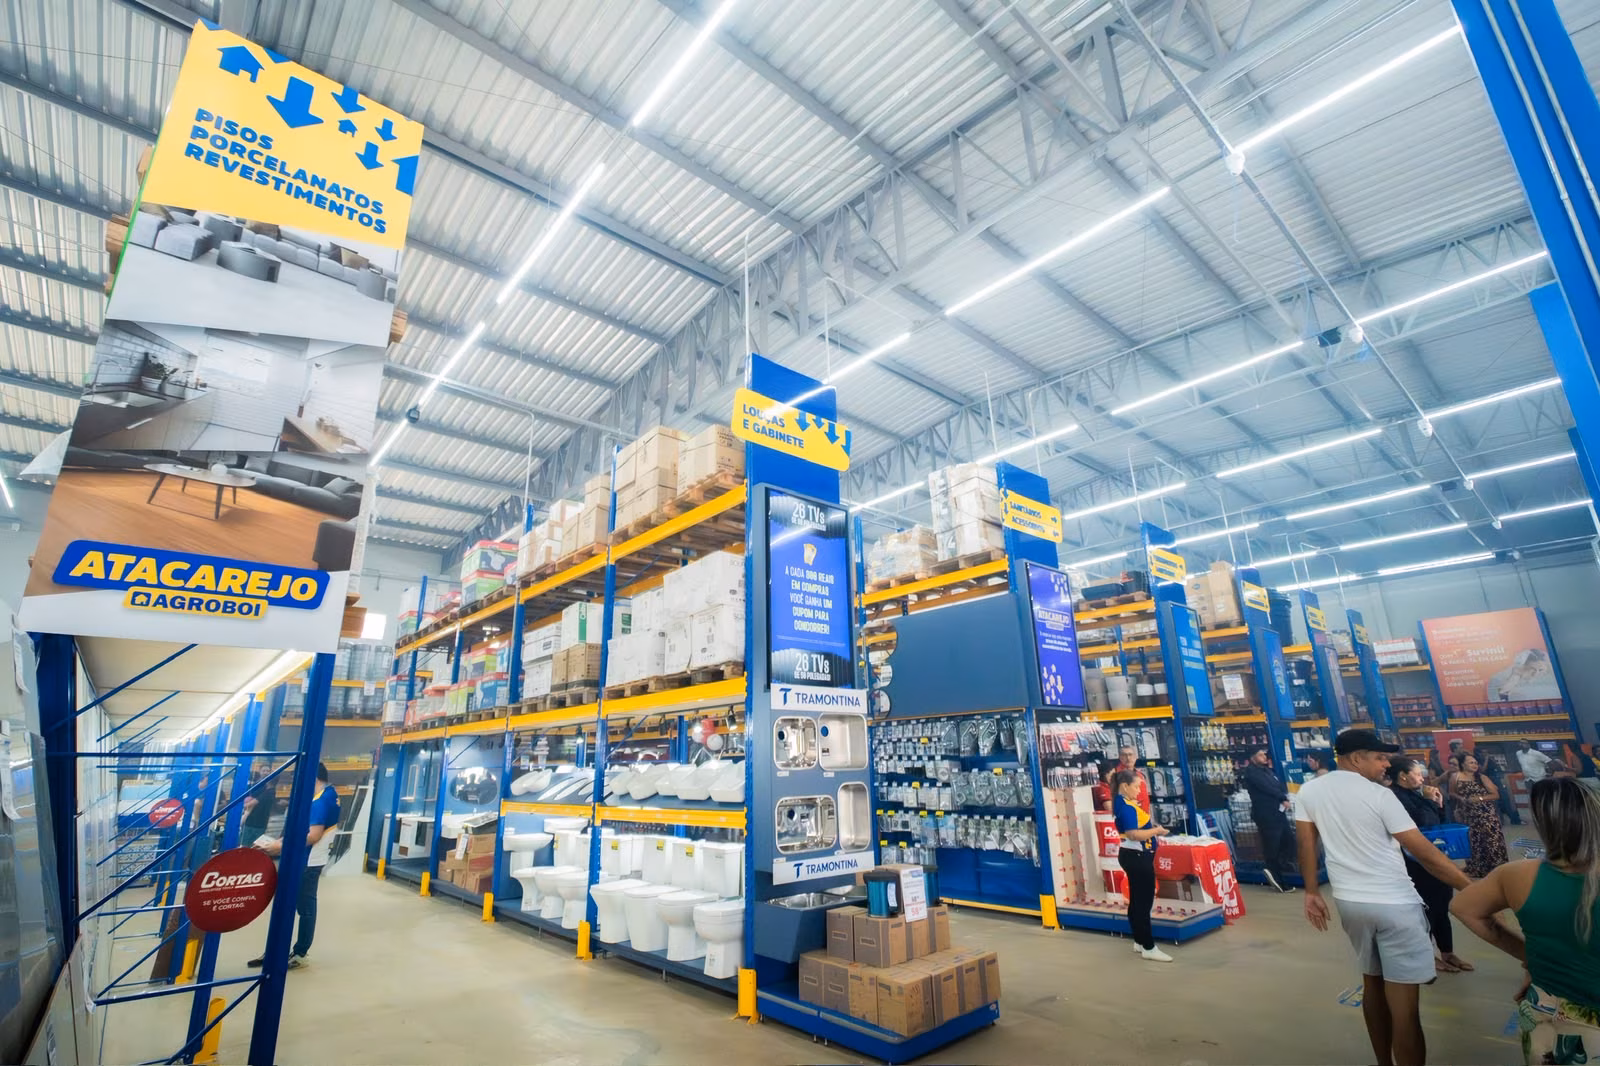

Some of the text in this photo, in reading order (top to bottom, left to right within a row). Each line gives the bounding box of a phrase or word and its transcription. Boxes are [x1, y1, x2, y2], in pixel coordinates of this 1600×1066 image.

[195, 108, 274, 150] PISOS
[190, 125, 384, 215] PORCELANATOS
[184, 142, 387, 234] REVESTIMENTOS
[743, 404, 785, 428] LOUAS
[743, 418, 749, 429] E
[752, 422, 804, 449] GABINETE
[807, 504, 825, 525] TVs
[69, 550, 319, 602] ATACAREJO
[785, 565, 790, 576] A
[789, 566, 805, 578] CADA
[818, 572, 835, 584] REAIS
[791, 579, 829, 596] EM COMPRAS
[152, 594, 261, 617] AGROBOI
[790, 592, 833, 609] VOCÊ GANHA UM
[792, 606, 829, 621] CUPOM PARA
[795, 653, 829, 674] 26 TVs
[795, 692, 861, 707] TRAMONTINA
[806, 859, 858, 875] TRAMONTINA
[200, 871, 263, 889] CORTAG
[212, 896, 231, 905] VOCÊ
